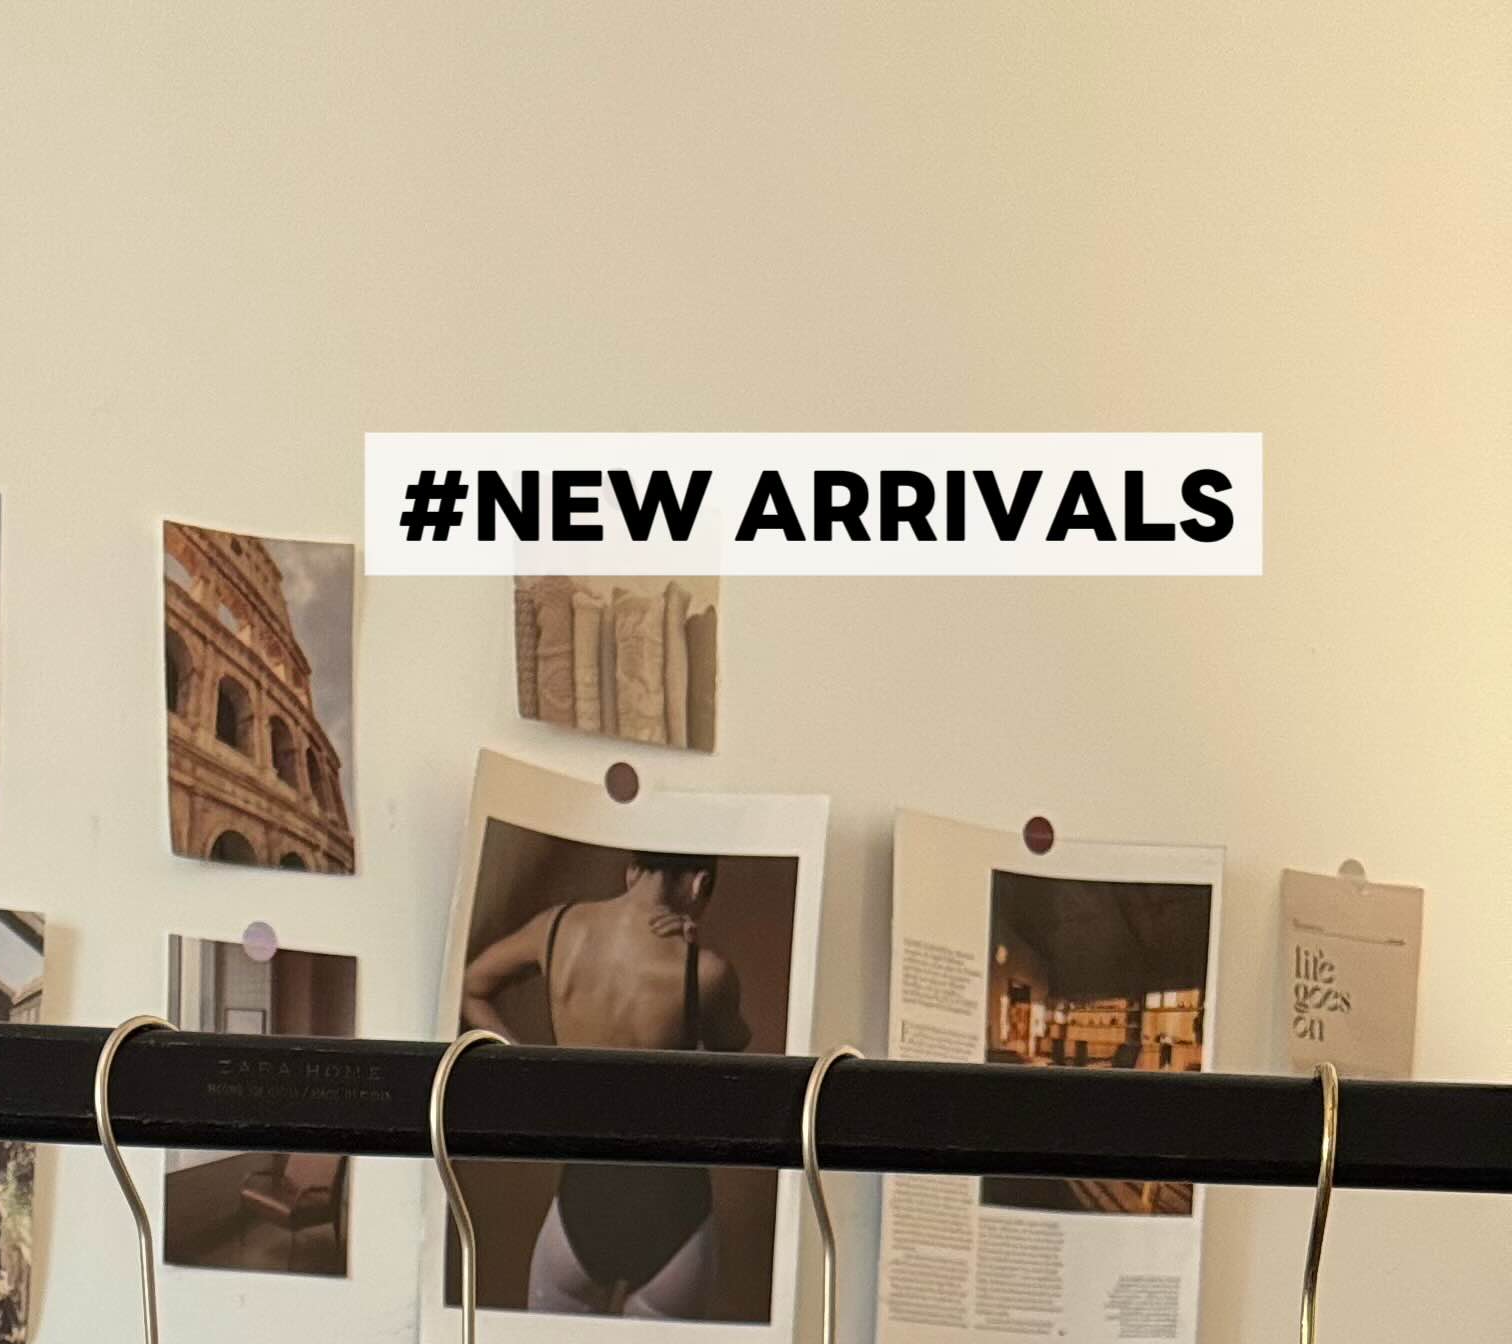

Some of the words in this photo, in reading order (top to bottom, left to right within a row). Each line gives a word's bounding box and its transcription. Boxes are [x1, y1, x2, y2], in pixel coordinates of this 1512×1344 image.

[1294, 943, 1336, 984] life
[1293, 983, 1352, 1014] goes
[1292, 1014, 1325, 1042] on
